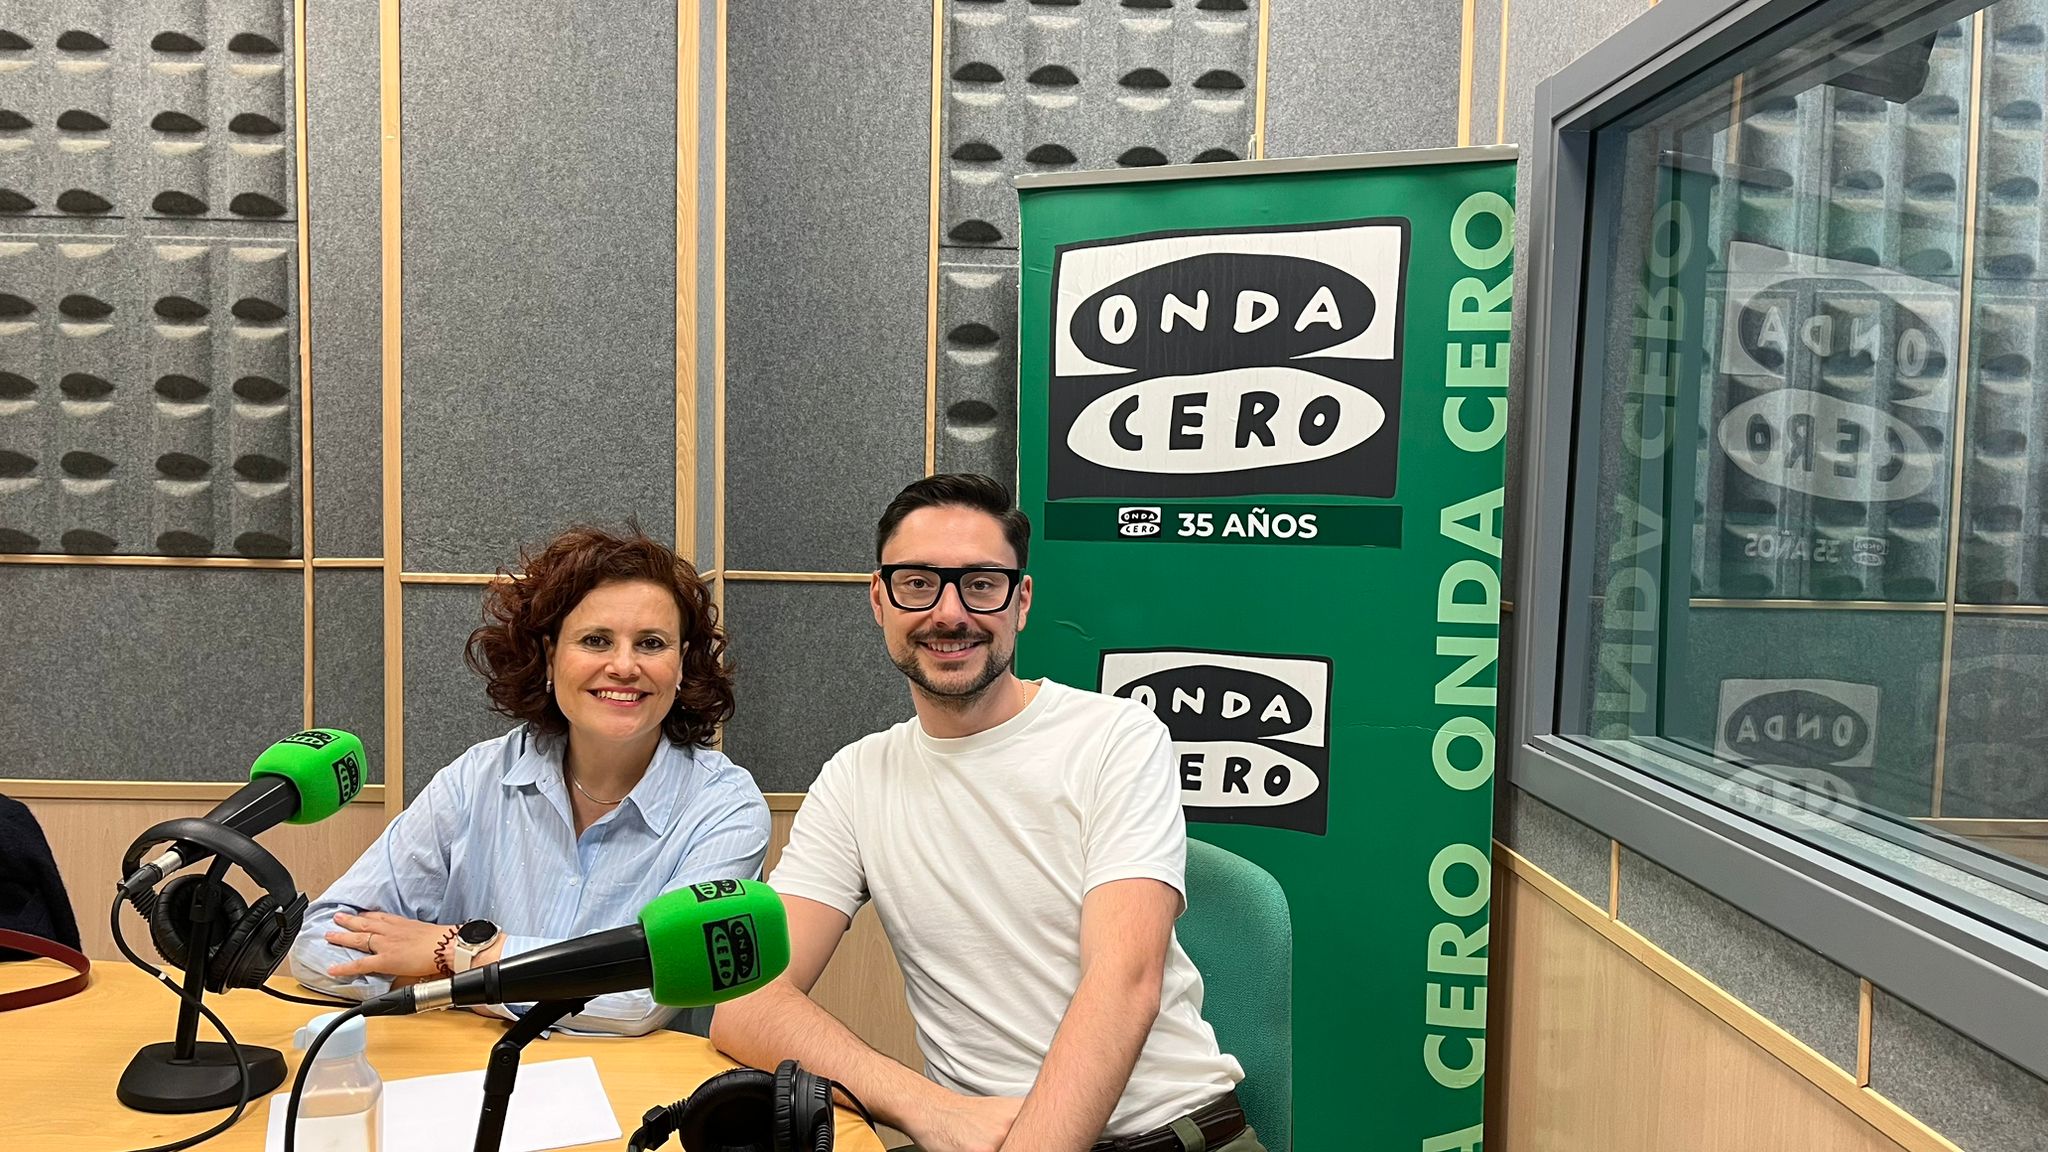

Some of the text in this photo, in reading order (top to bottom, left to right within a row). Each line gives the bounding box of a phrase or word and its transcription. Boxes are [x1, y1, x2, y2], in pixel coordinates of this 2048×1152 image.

[1099, 286, 1342, 345] ONDA
[1443, 191, 1515, 452] CERO
[1108, 391, 1341, 451] CERO
[1123, 513, 1155, 521] ONDA
[1125, 525, 1155, 533] CERO
[1177, 507, 1318, 539] 35 AÑOS
[1431, 486, 1505, 791] ONDA
[1131, 685, 1291, 724] ONDA
[1180, 753, 1291, 797] ERO
[715, 933, 731, 979] CERO
[735, 926, 749, 974] ONDA
[1423, 843, 1491, 1089] CERO
